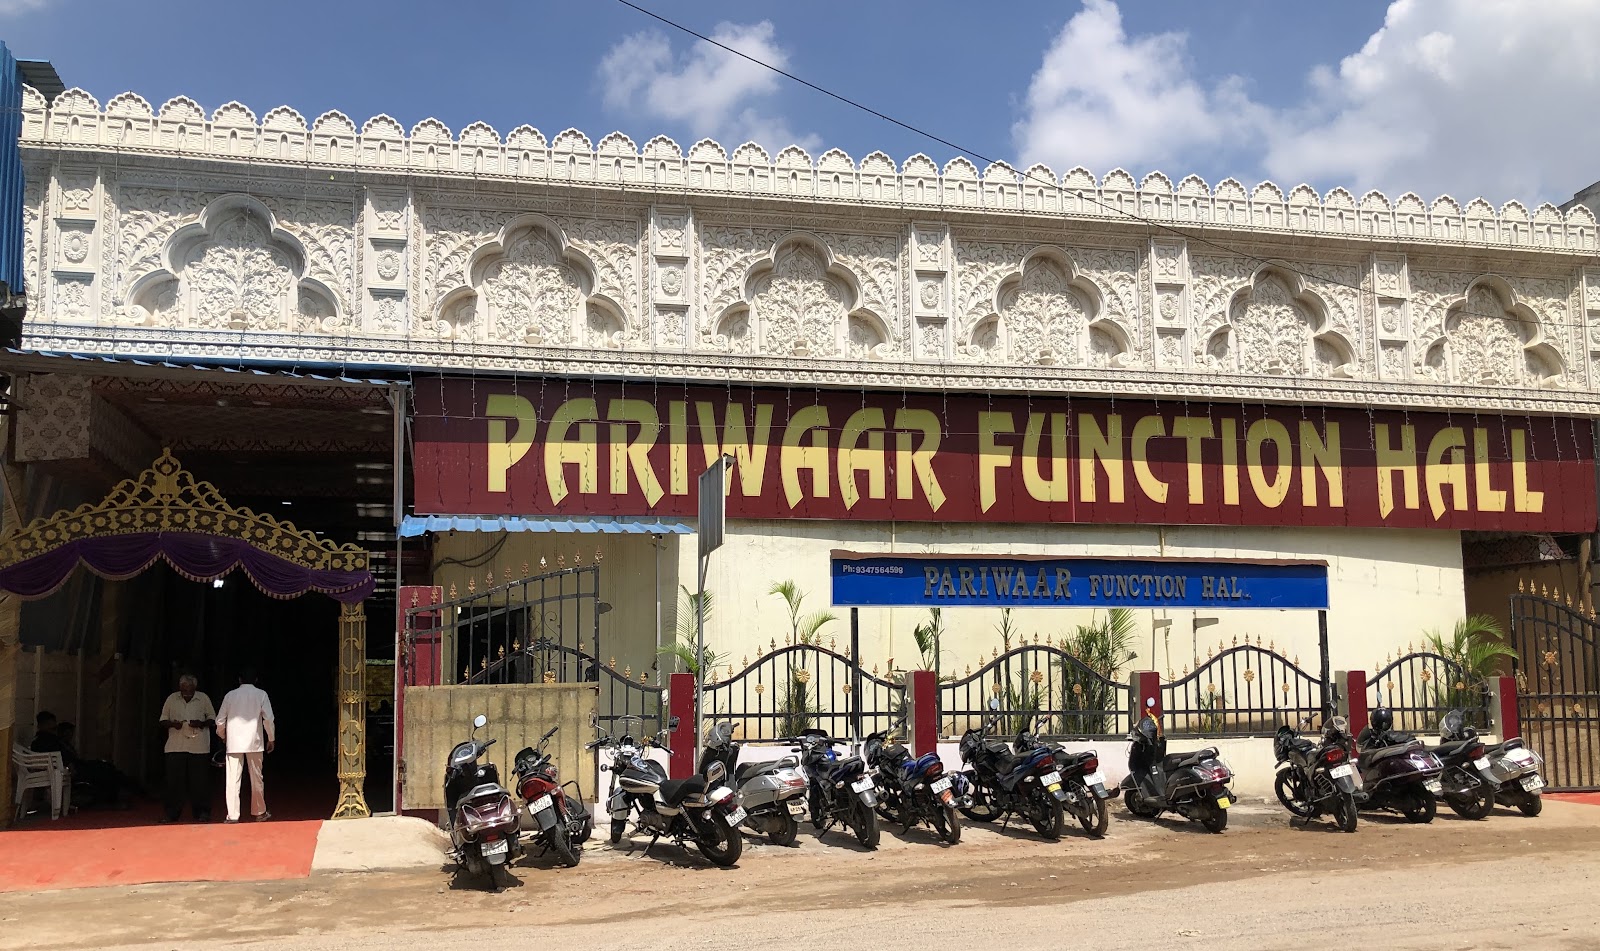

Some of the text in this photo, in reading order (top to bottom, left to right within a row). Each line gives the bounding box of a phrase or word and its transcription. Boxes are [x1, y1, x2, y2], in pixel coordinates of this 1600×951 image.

[484, 393, 1545, 521] PARIWAAR FUNCTION HALL
[923, 567, 1073, 599] PARIWAAR
[1088, 574, 1188, 598] FUNCTION
